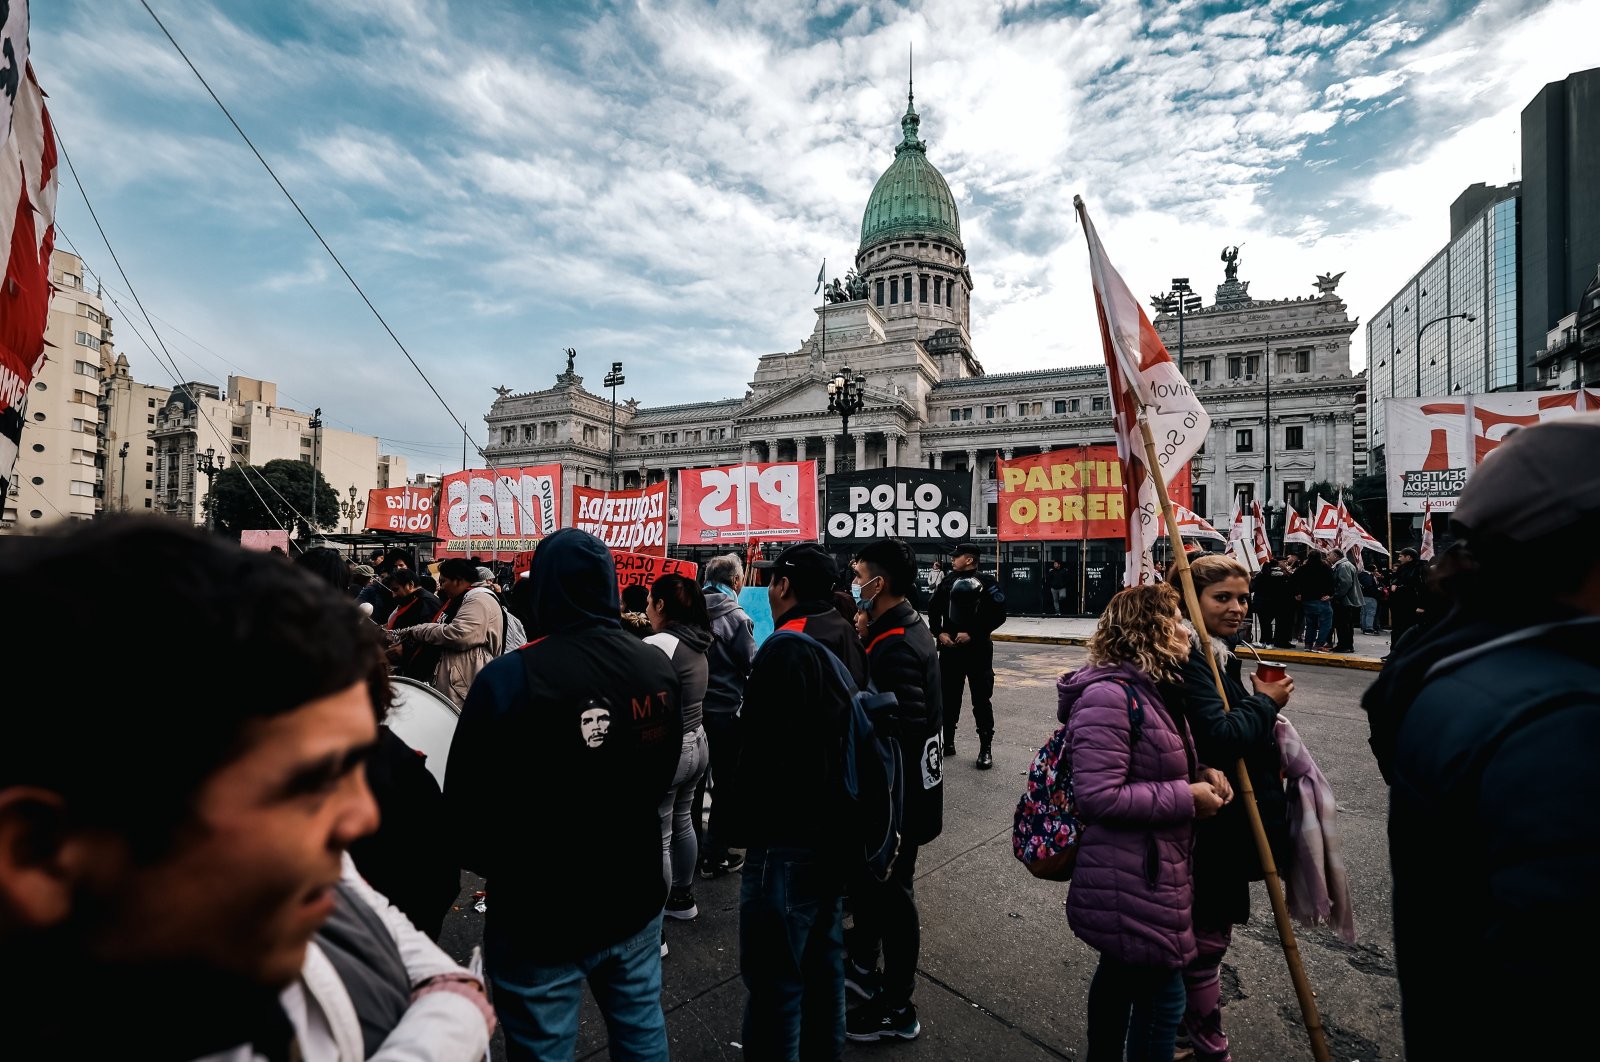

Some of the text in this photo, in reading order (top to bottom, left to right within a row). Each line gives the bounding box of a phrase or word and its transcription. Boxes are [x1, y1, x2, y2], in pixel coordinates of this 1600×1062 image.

[1002, 461, 1122, 493] PARTI
[849, 483, 942, 513] POLO
[1009, 493, 1126, 525] OBRER
[827, 510, 968, 538] OBRERO
[662, 560, 683, 575] EL
